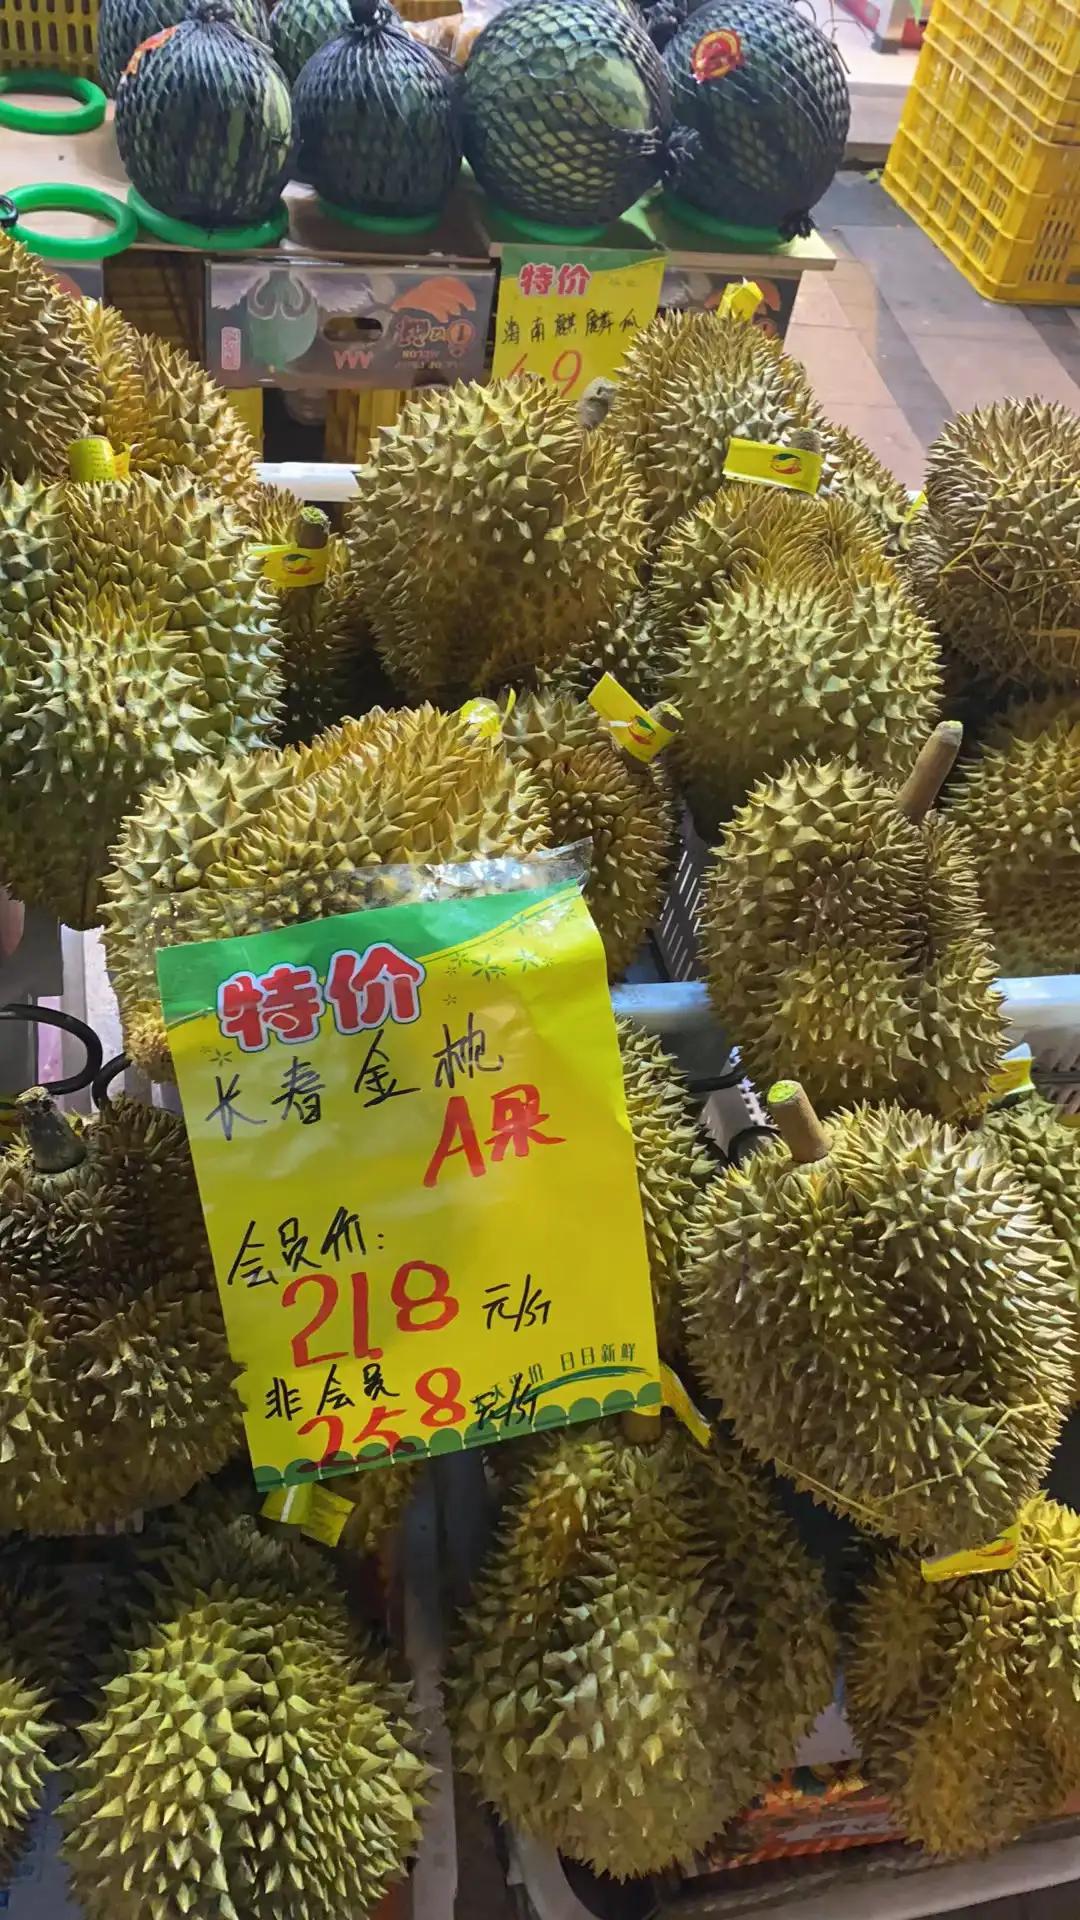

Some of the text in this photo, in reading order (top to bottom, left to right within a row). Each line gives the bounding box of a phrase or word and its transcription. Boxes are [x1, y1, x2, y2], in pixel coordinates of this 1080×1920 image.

[519, 263, 592, 297] 特价
[217, 943, 426, 1052] 特价
[423, 1084, 567, 1188] A果
[560, 1343, 636, 1372] 日日新鲜
[265, 1363, 400, 1421] 非会员
